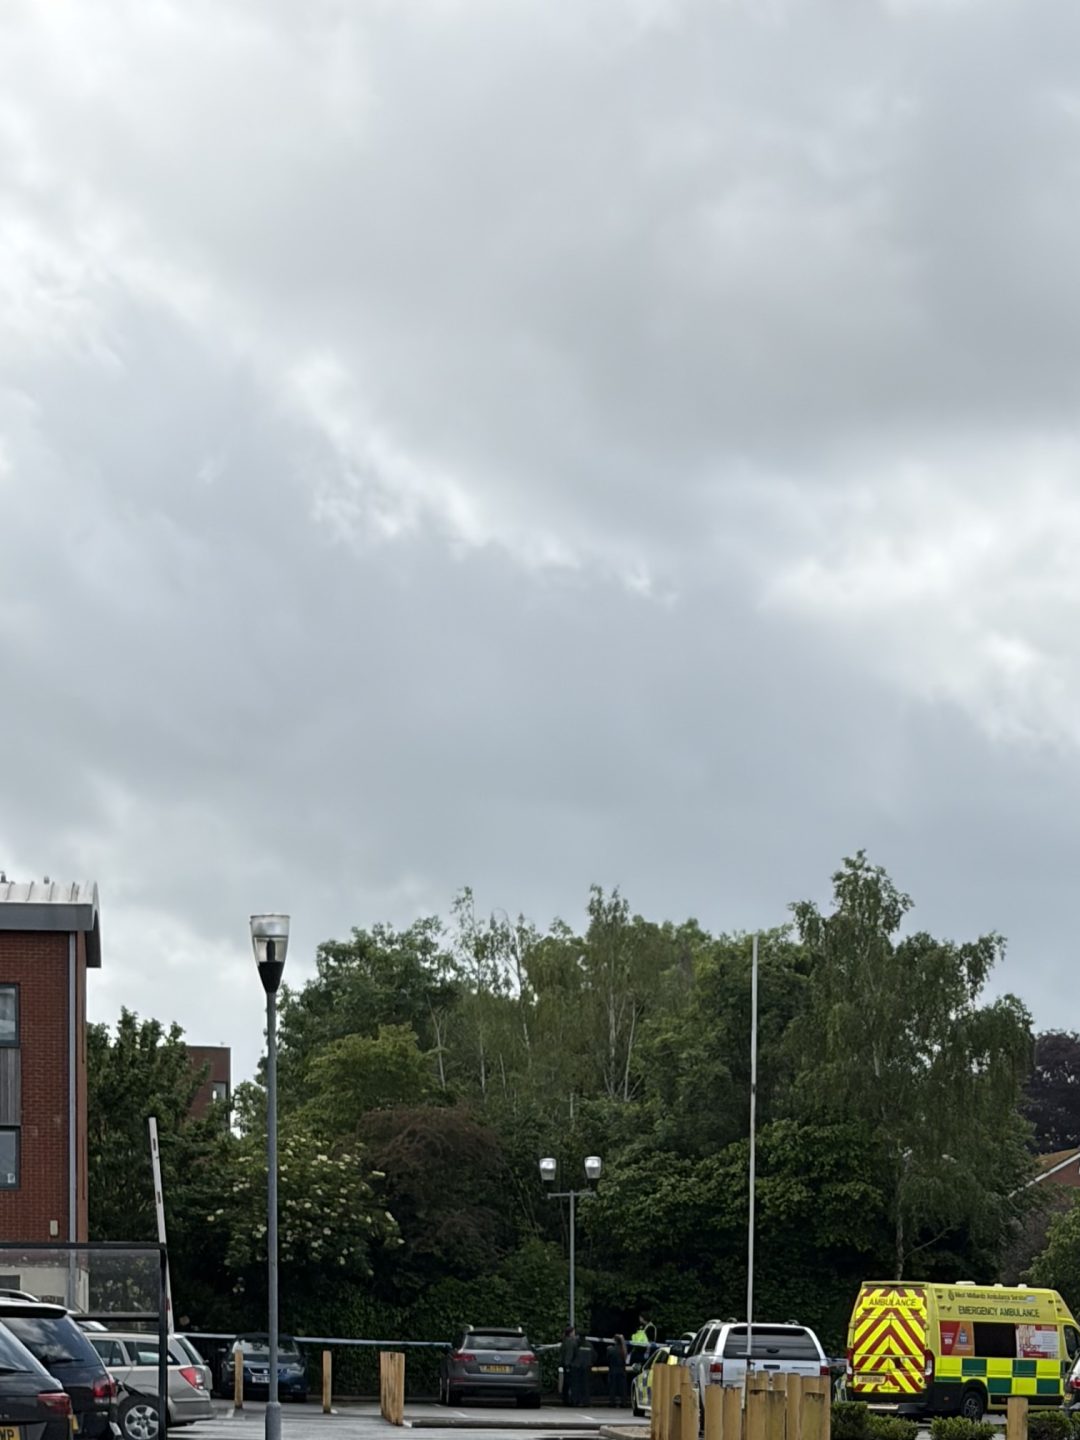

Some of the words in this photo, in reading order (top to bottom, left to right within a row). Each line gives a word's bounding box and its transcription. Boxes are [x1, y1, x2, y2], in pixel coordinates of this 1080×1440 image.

[868, 1297, 917, 1306] AMBULANCE
[958, 1305, 998, 1316] EMERGENCY
[1000, 1306, 1040, 1318] AMBULANCE
